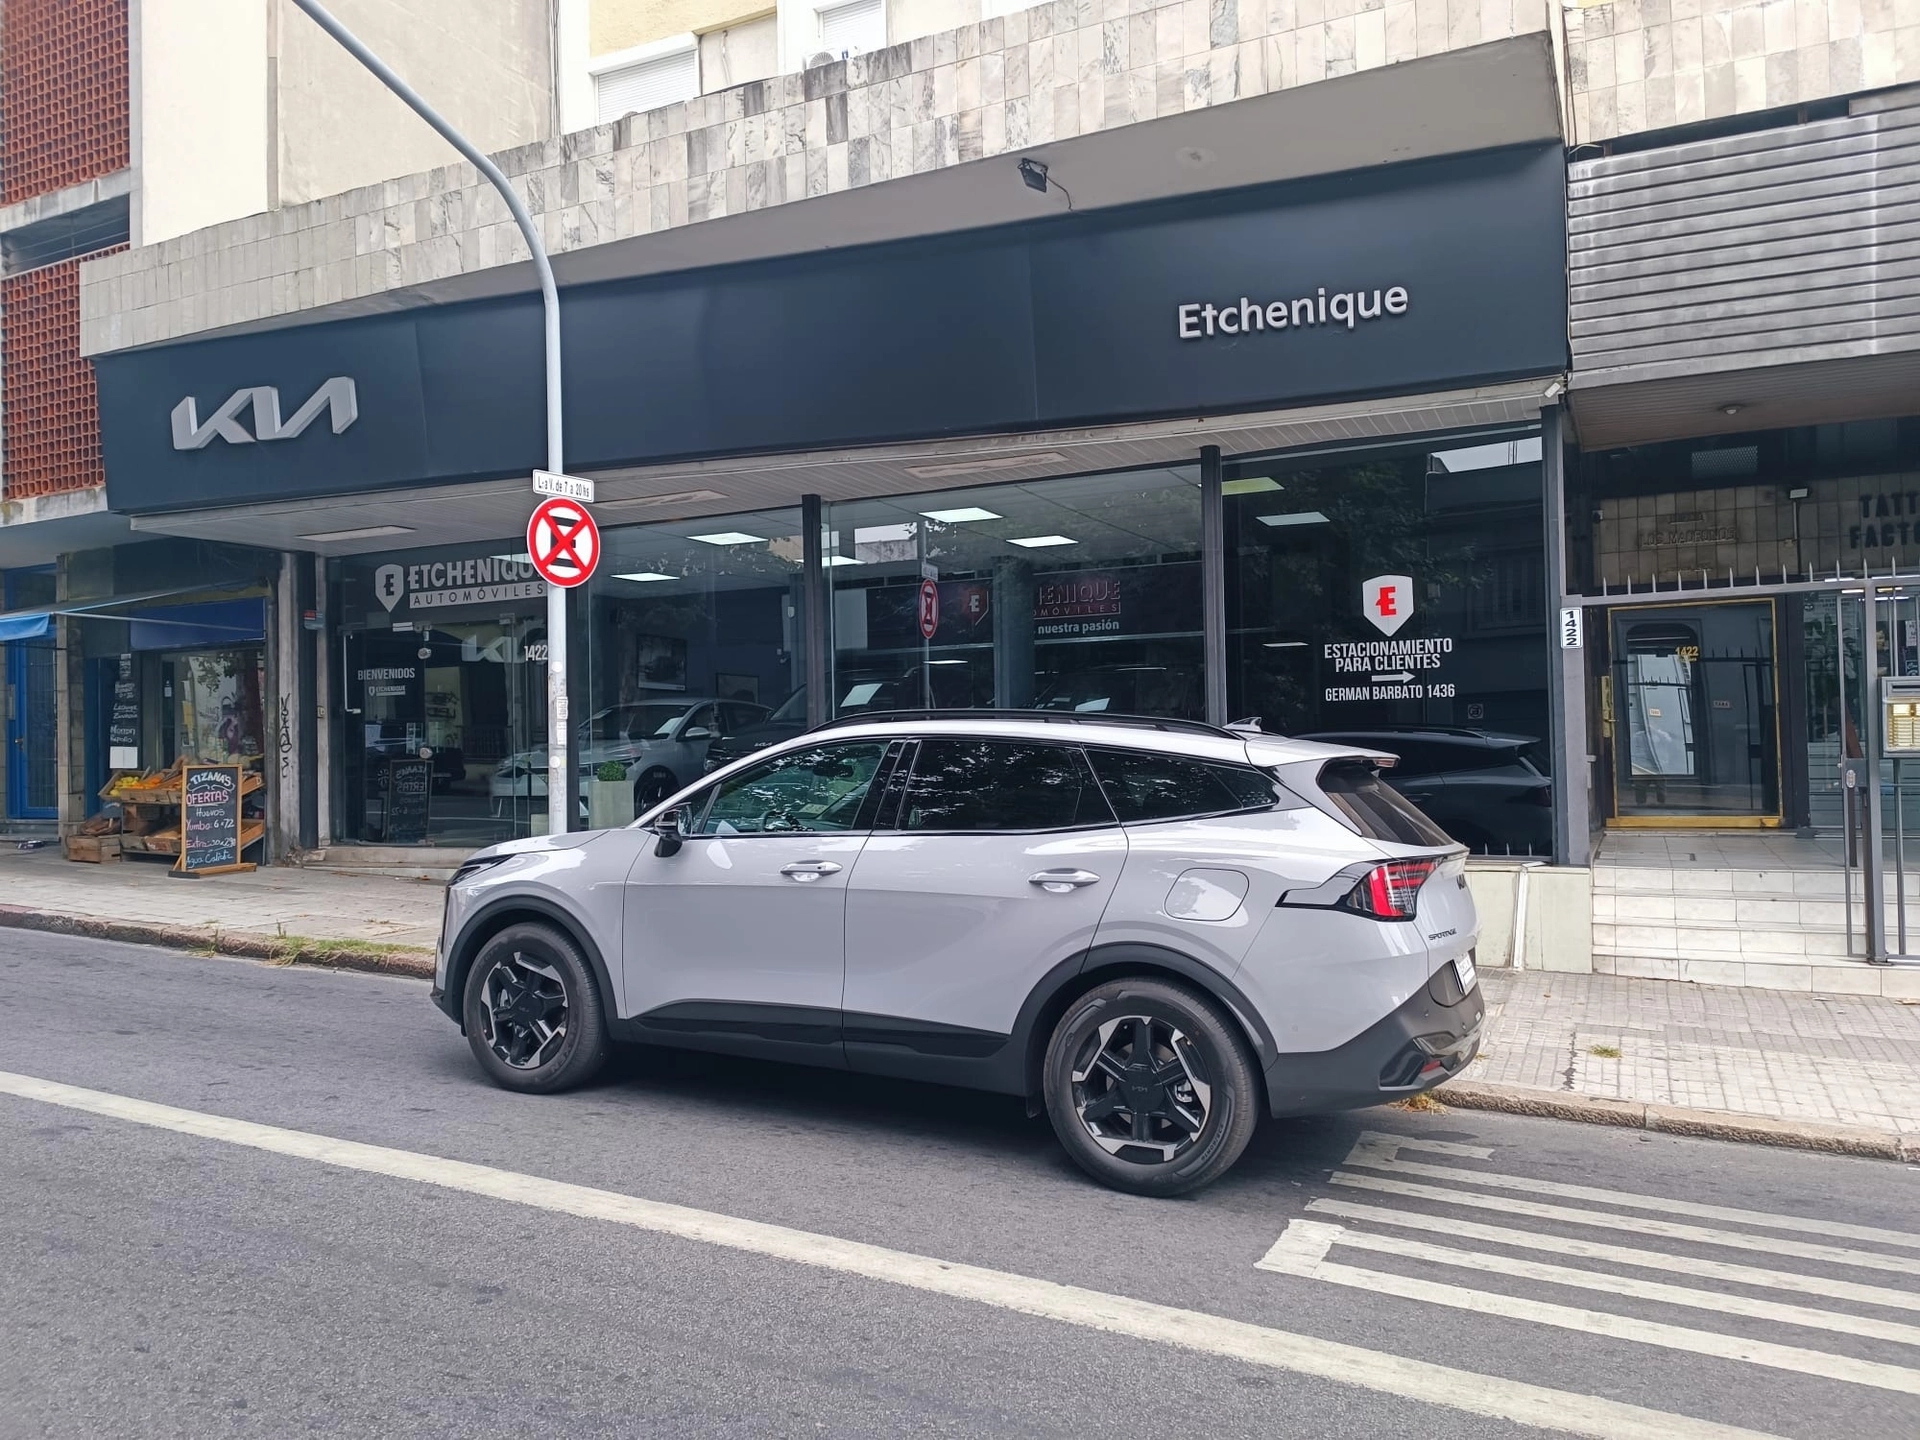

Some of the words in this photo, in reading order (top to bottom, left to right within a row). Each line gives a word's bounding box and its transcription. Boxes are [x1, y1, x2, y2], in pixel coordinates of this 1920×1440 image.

[1178, 286, 1408, 338] Etchenique
[171, 376, 358, 450] KIA
[576, 483, 582, 496] 20
[407, 556, 542, 590] ETCHENIQU
[413, 583, 544, 606] AUTOMÓVILES
[1038, 622, 1080, 635] nuestra
[1082, 618, 1120, 634] pasión
[1563, 611, 1577, 647] 1422
[524, 644, 548, 662] 1422
[1324, 637, 1453, 659] ESTACIONAMIENTO
[1675, 645, 1700, 658] 1422
[1335, 657, 1372, 673] PARA
[1375, 653, 1441, 671] CLIENTES
[357, 667, 416, 681] BIENVENIDOS
[1325, 687, 1370, 702] GERMAN
[1372, 685, 1423, 700] BARBATO
[1427, 683, 1455, 698] 1436
[187, 790, 230, 805] OFERTAS
[1428, 927, 1458, 941] SPORTAGE
